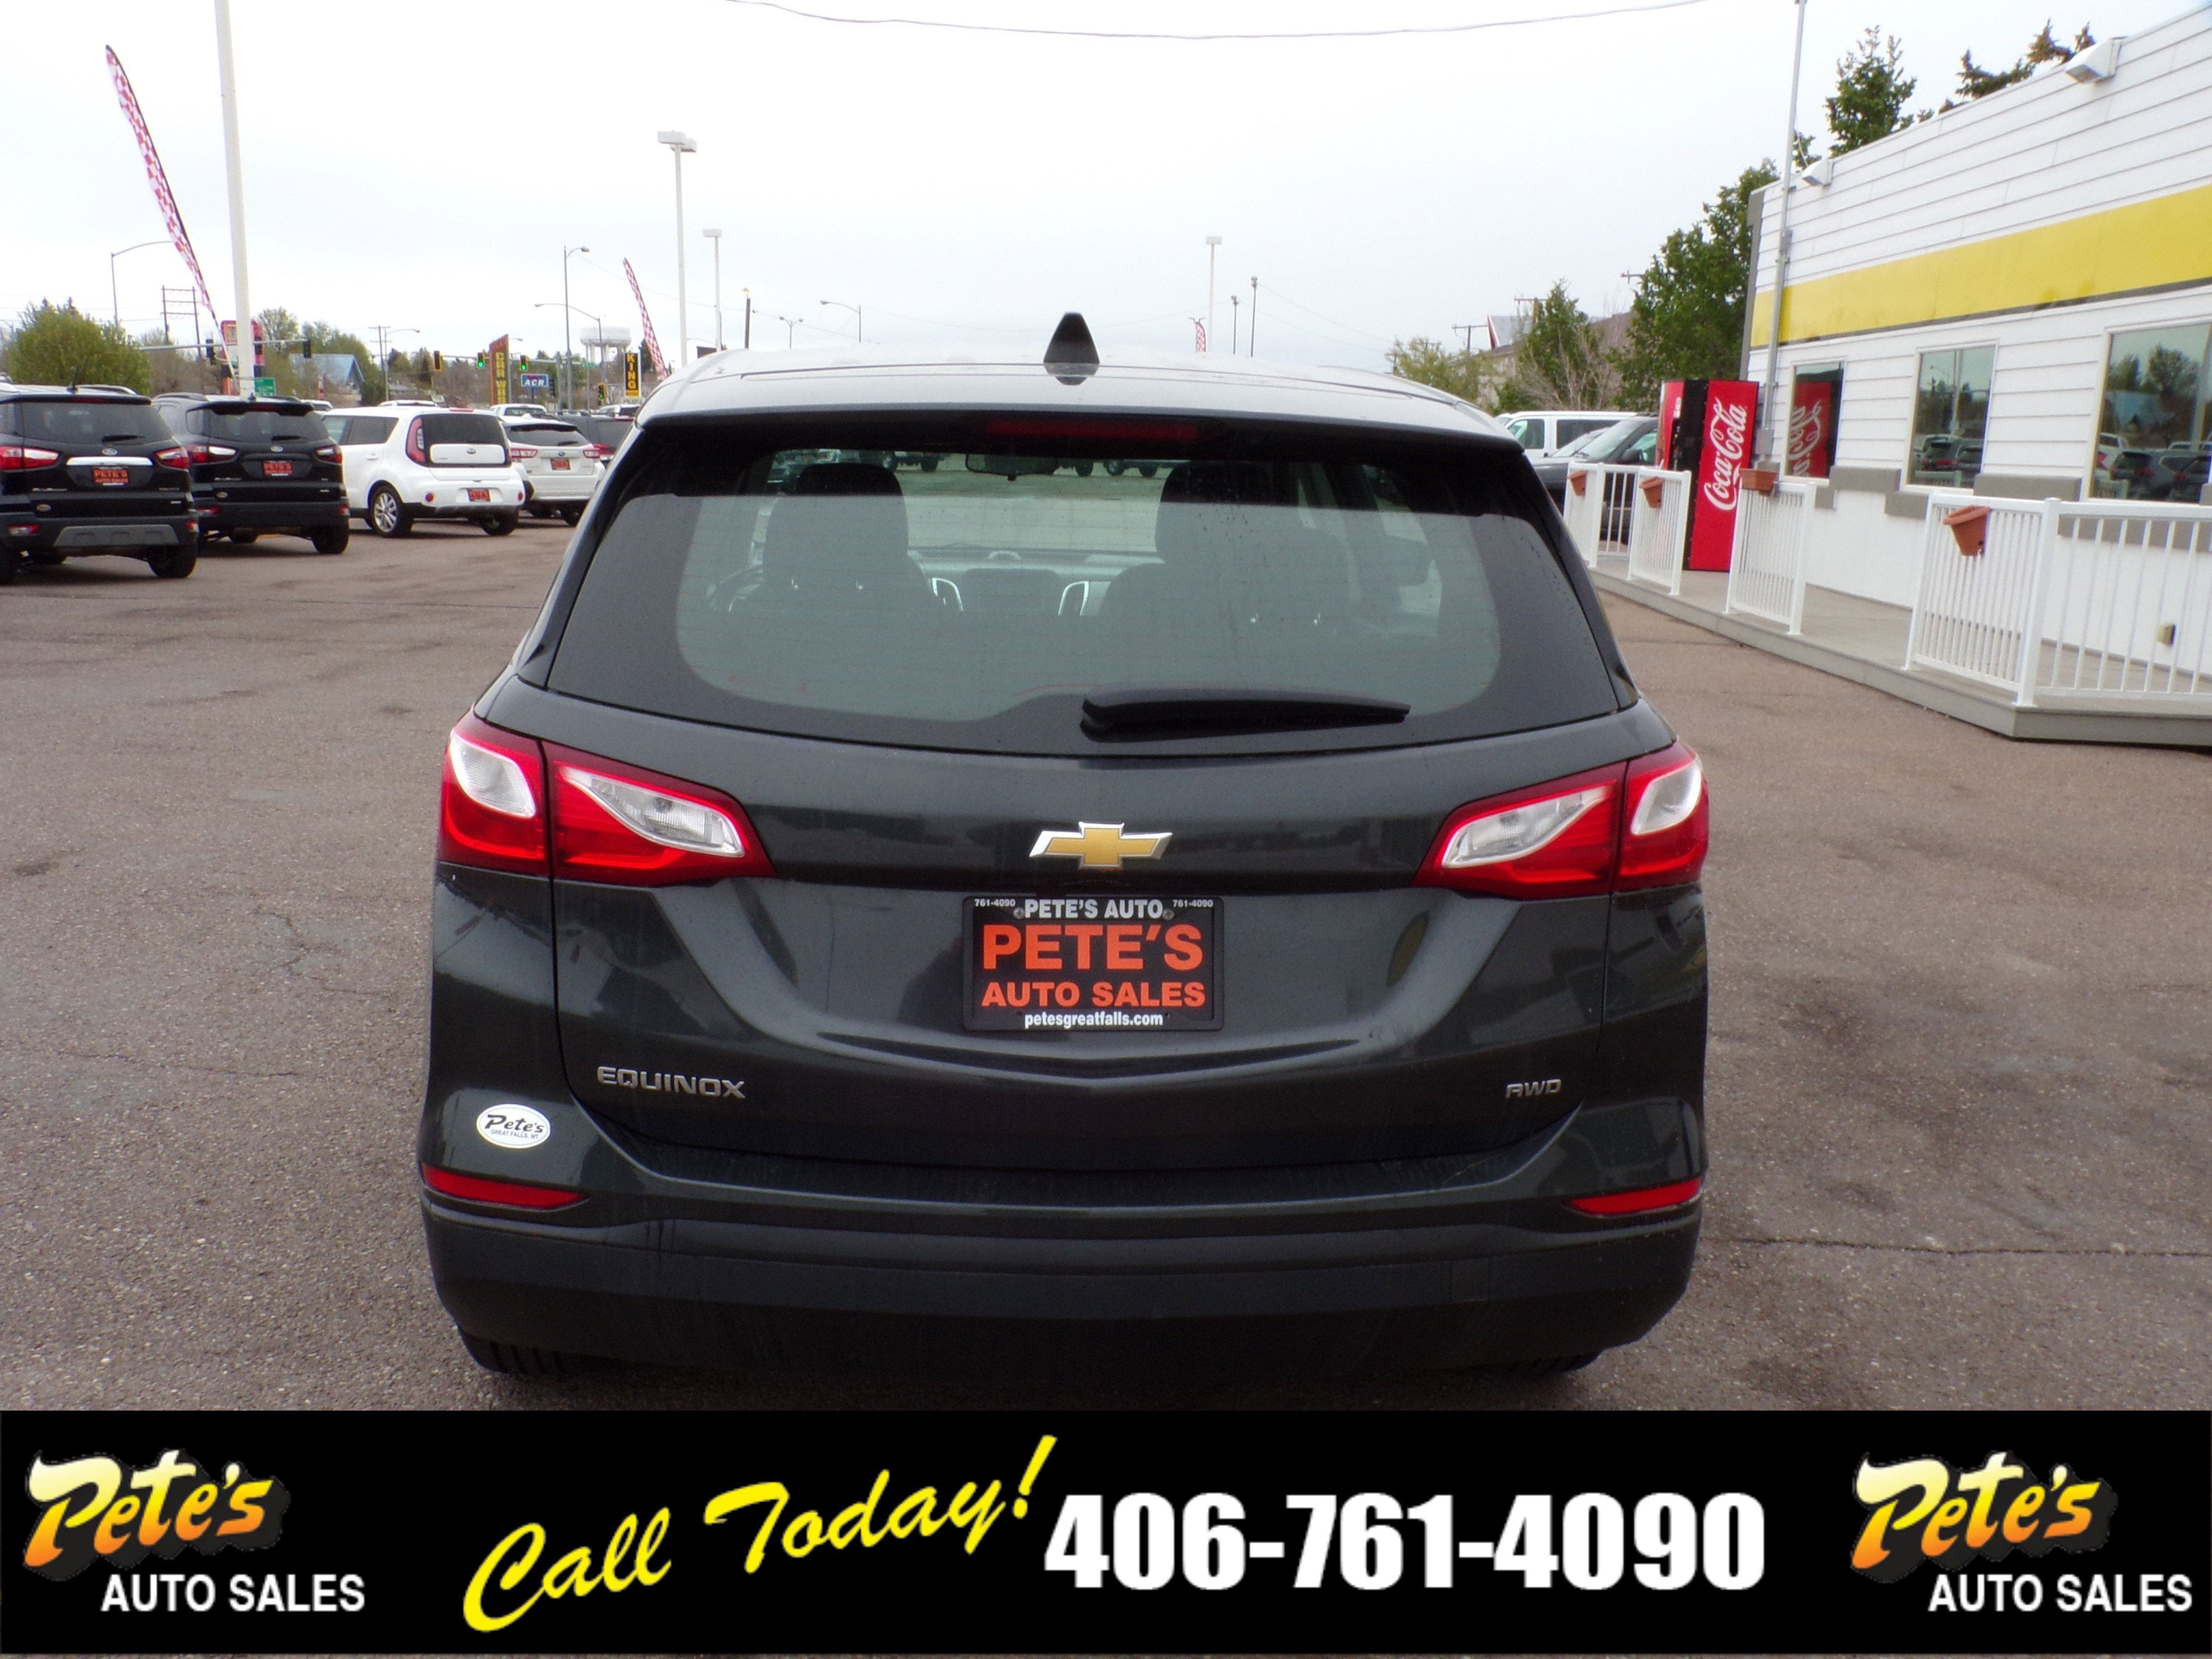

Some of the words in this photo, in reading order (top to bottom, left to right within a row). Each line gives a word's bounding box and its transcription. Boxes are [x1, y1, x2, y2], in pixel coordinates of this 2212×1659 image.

[626, 354, 636, 389] KING
[1704, 397, 1747, 510] Coca-Cola
[1025, 899, 1098, 918] PETE'S
[1104, 900, 1163, 918] AUTO
[983, 924, 1204, 970] PETE'S
[981, 982, 1080, 1007] AUTO
[1092, 981, 1206, 1008] SALES
[1024, 1011, 1163, 1029] petesgreatfalls.com
[597, 1066, 746, 1099] EQUINOX
[1506, 1079, 1562, 1098] AWD
[484, 1114, 545, 1133] Pete's
